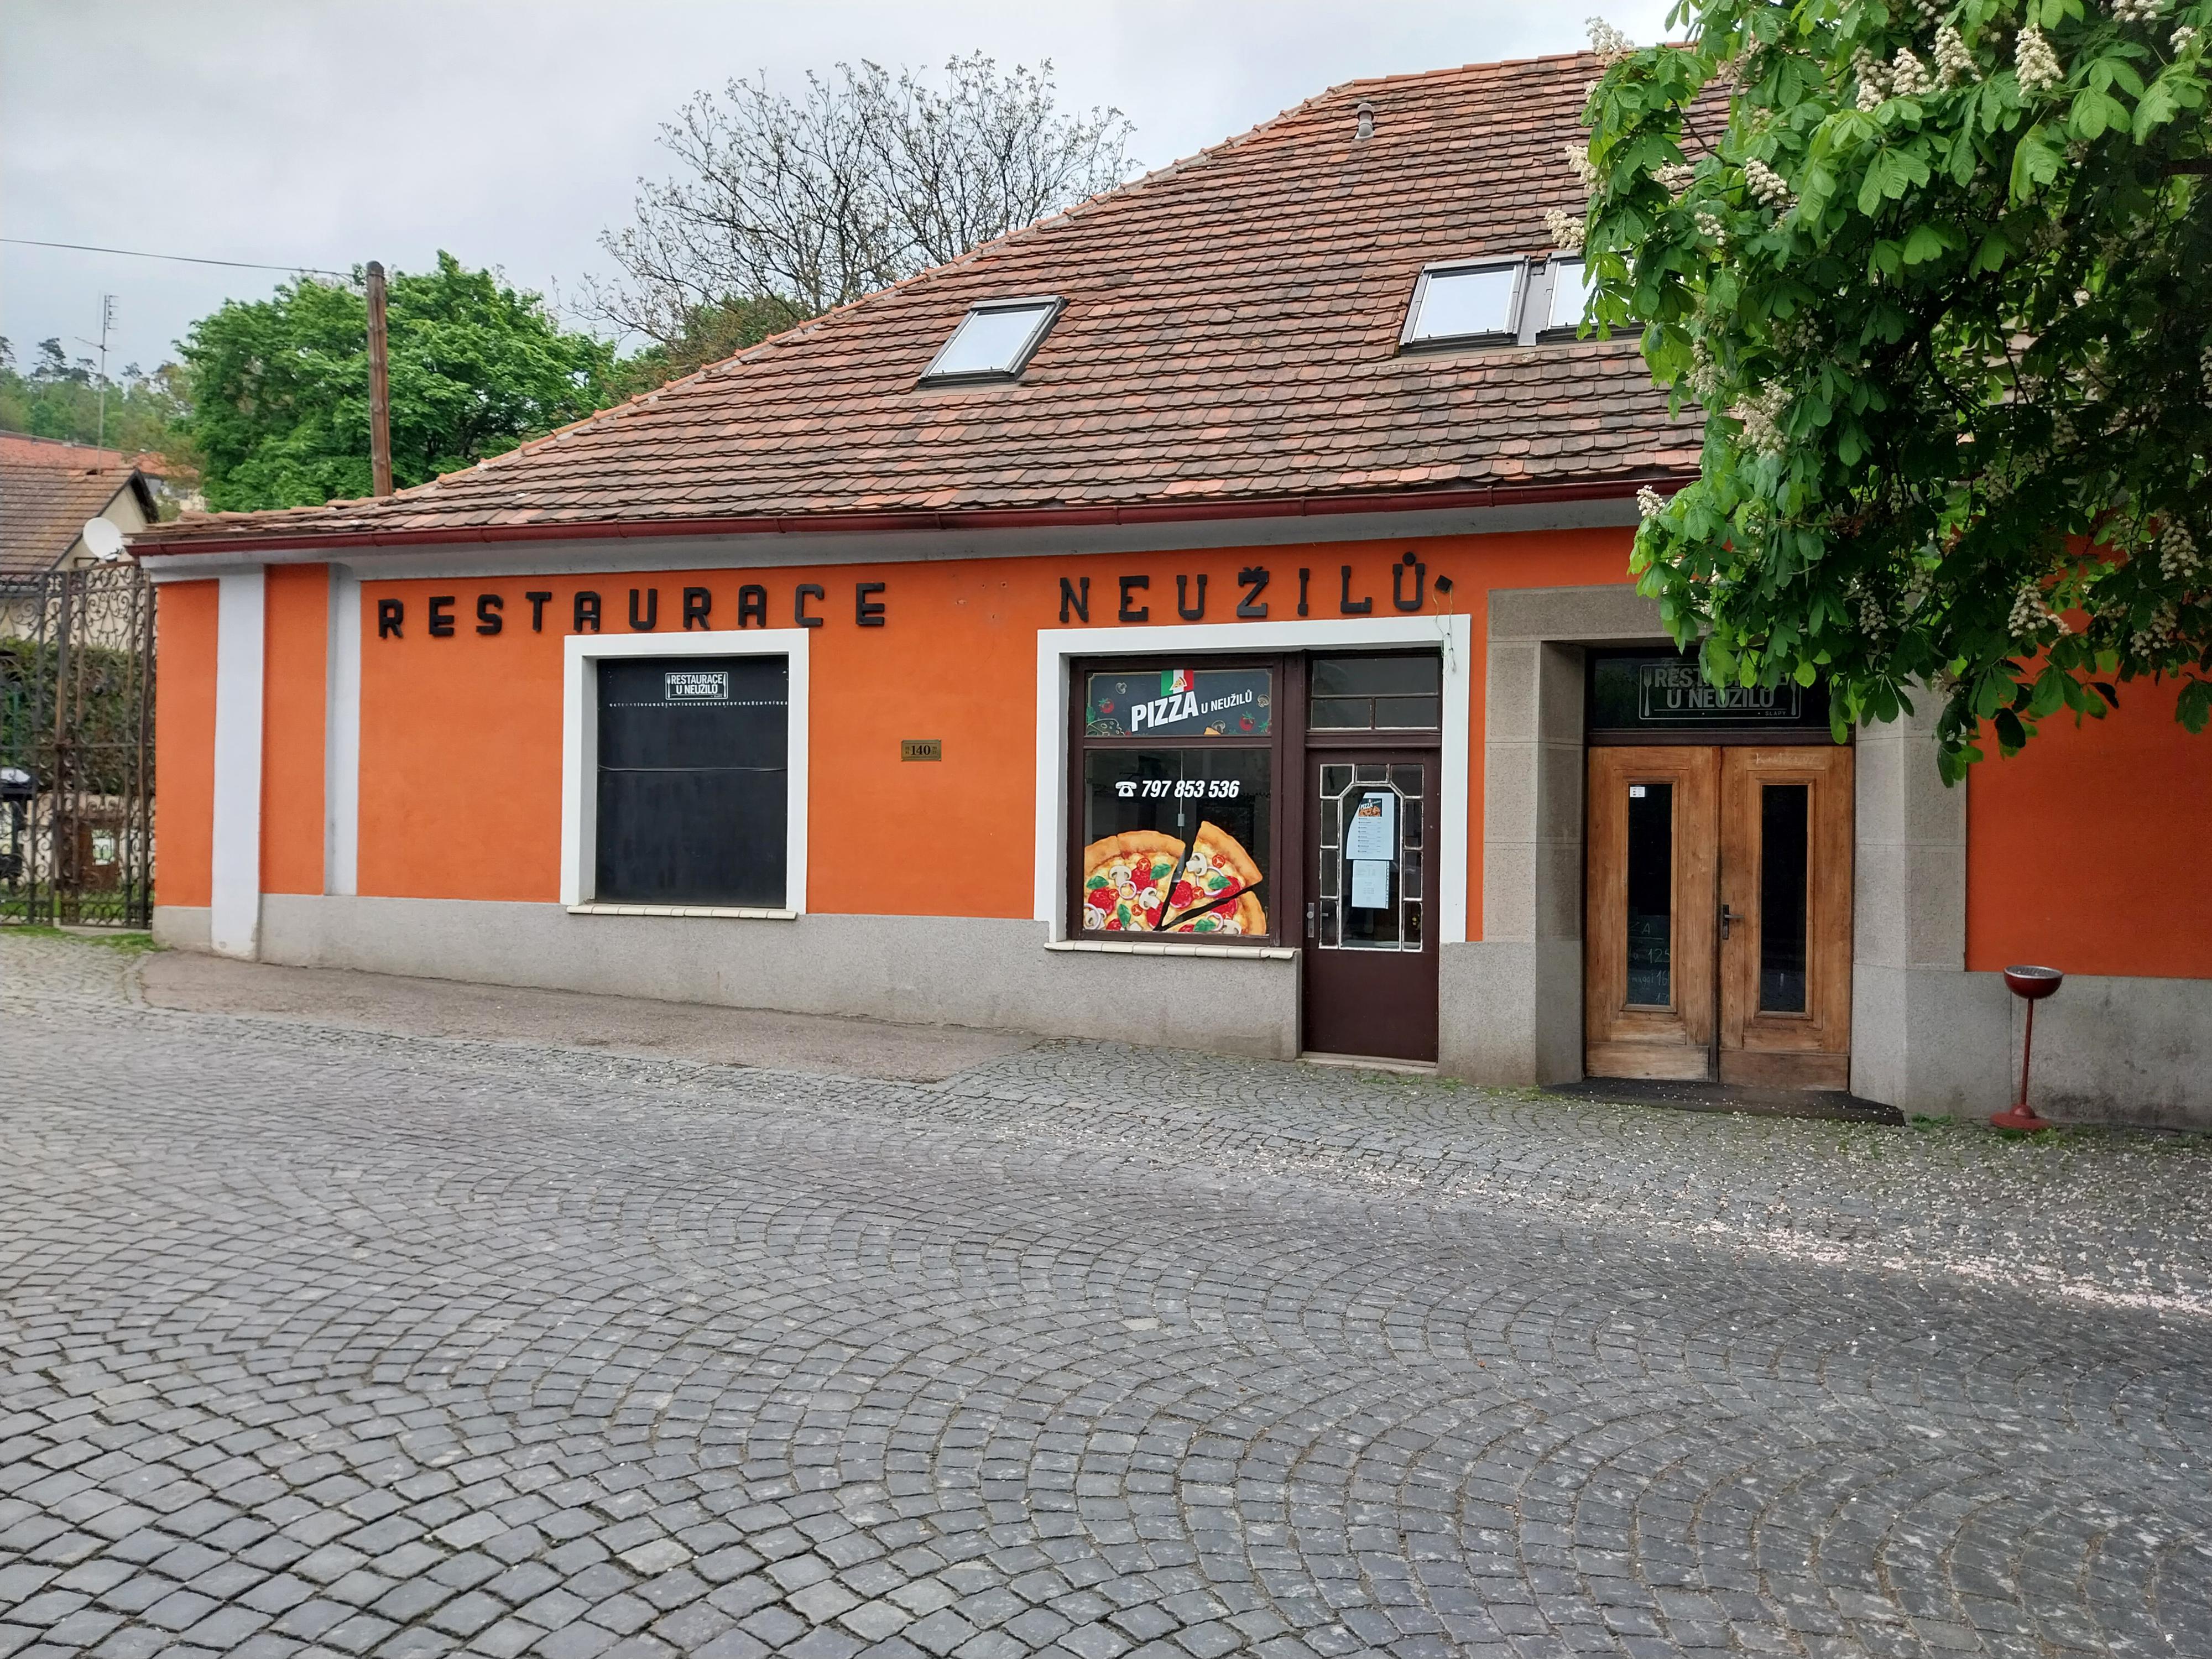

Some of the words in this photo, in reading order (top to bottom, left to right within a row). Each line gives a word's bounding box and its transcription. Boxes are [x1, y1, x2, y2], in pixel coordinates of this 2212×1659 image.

[378, 582, 885, 638] RESTAURACE
[1059, 552, 1426, 622] NEUŽILŮ
[671, 674, 723, 685] RESTAURACE
[676, 685, 682, 694] U
[1667, 689, 1681, 708] U
[1131, 691, 1199, 732] PIZZA
[1201, 703, 1208, 714] U
[1211, 689, 1253, 712] NEUŽILŮ
[911, 745, 931, 755] 140
[1141, 780, 1172, 797] 797
[1174, 780, 1206, 798] 853
[1208, 780, 1240, 798] 536
